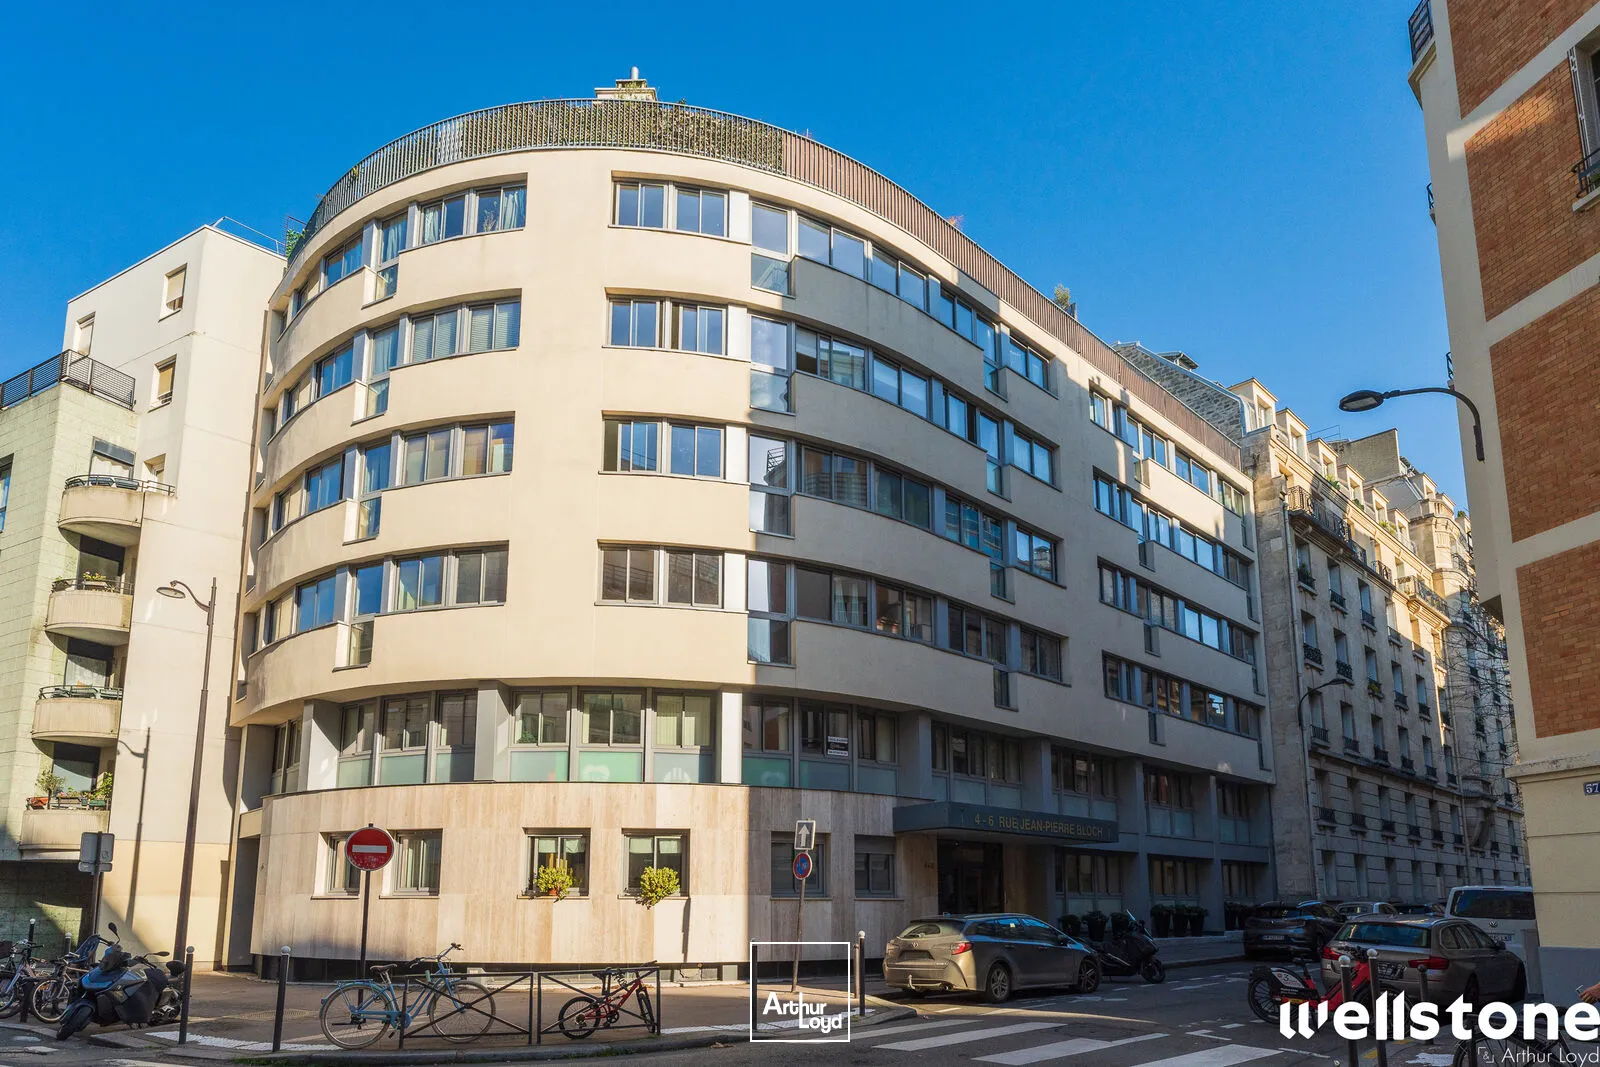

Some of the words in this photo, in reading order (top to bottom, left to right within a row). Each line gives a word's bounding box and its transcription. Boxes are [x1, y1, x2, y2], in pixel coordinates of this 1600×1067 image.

[1585, 783, 1599, 793] 57
[999, 815, 1018, 829] RUE
[1019, 818, 1075, 835] JEAN-PIERRE
[1076, 824, 1103, 838] BLOCH
